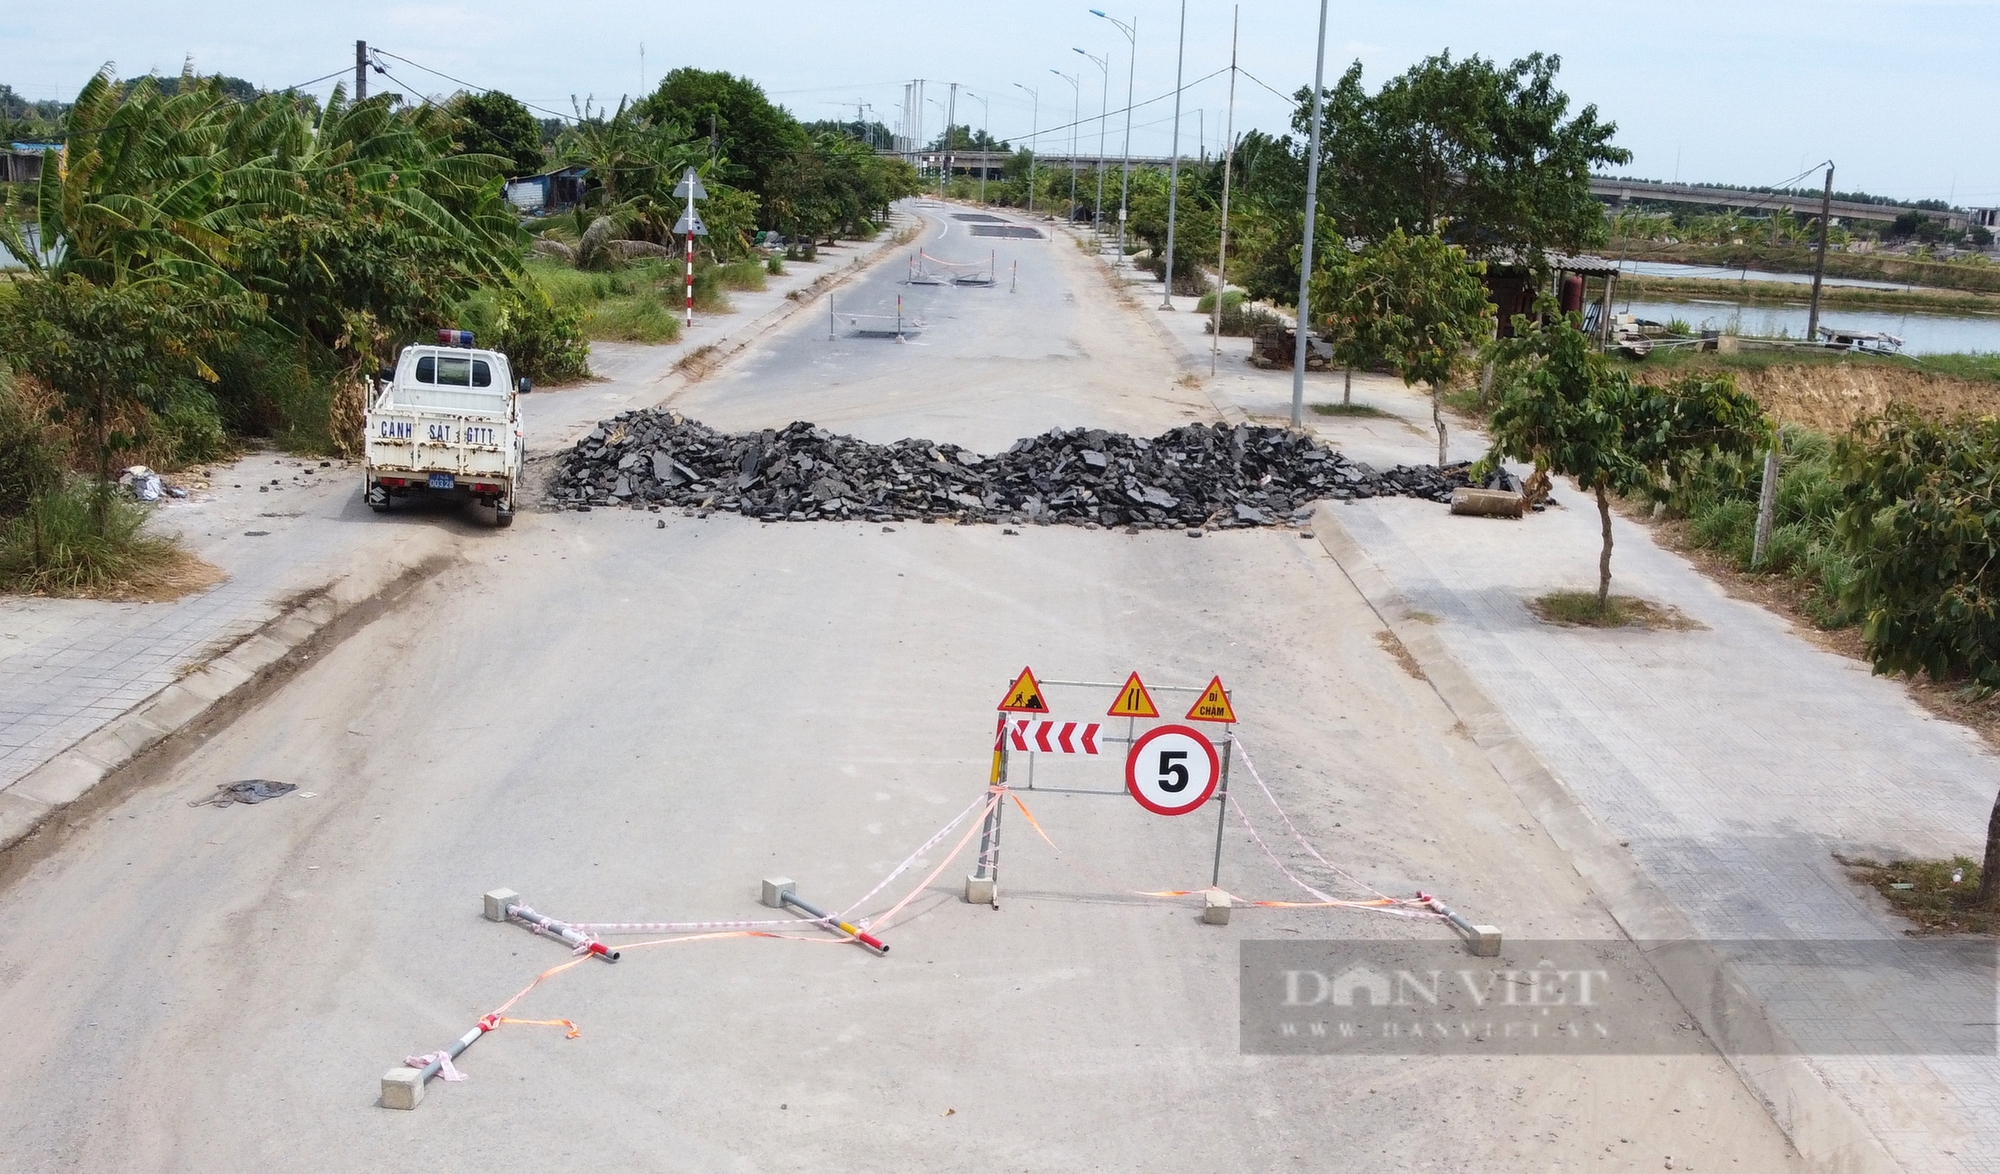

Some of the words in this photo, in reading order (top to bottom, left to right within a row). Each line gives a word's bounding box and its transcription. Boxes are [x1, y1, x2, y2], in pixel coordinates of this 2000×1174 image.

[429, 421, 451, 440] SÁT
[466, 426, 493, 443] GTTT
[1158, 751, 1189, 793] 5
